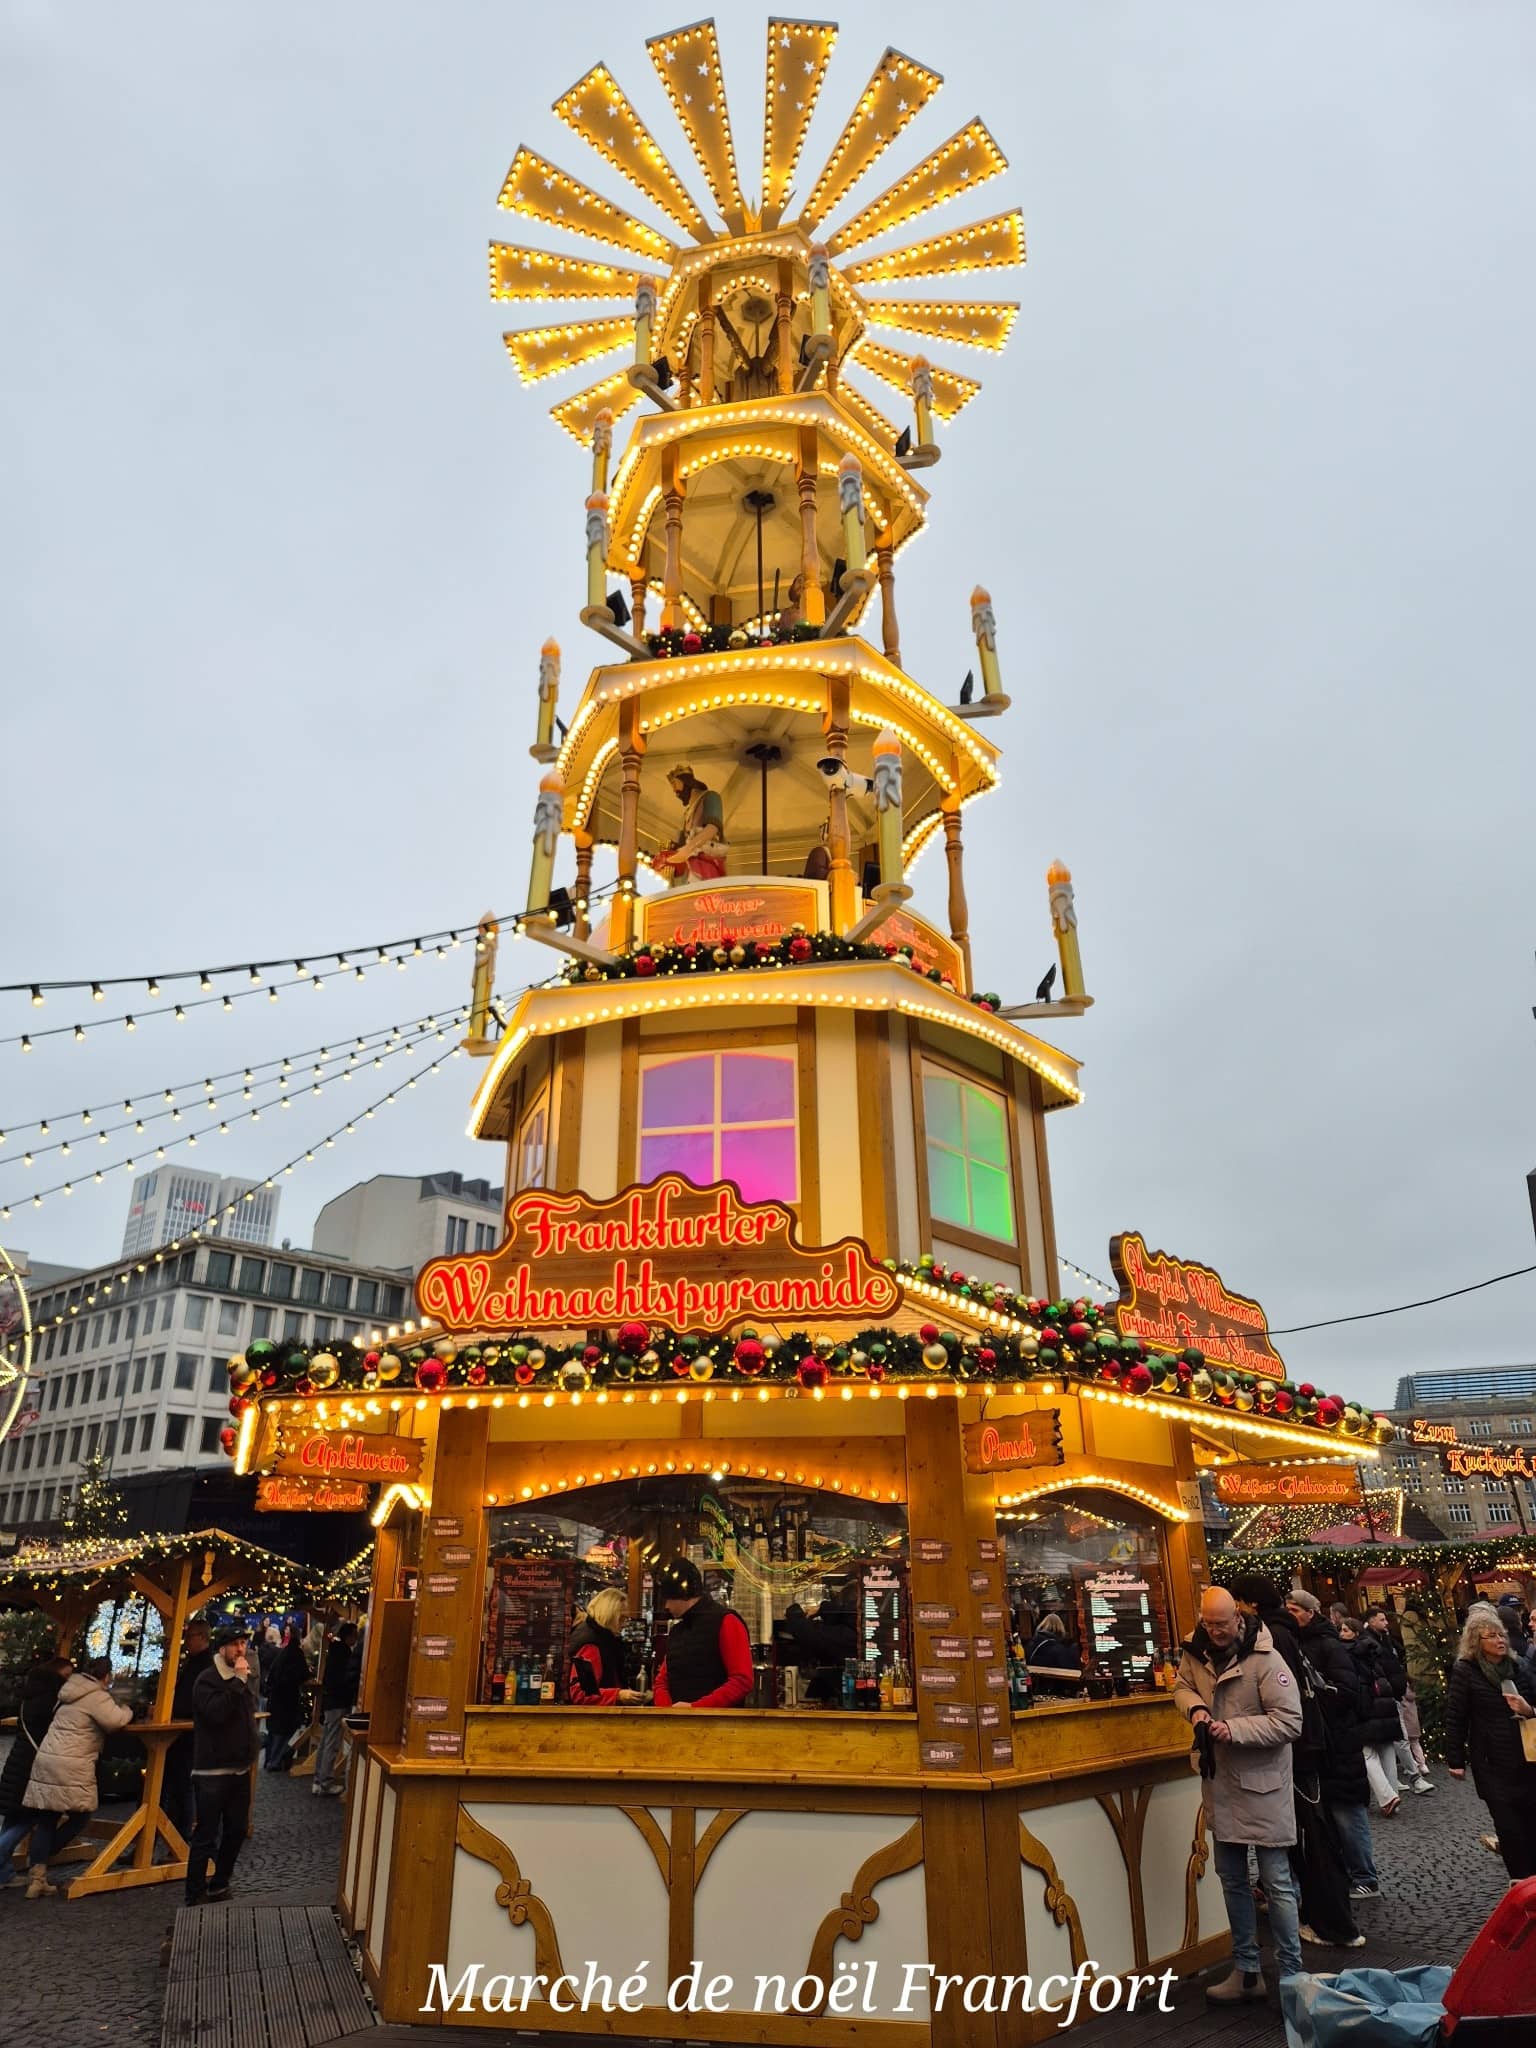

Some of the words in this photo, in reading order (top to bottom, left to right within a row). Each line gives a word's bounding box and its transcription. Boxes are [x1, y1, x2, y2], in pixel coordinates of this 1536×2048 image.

[673, 916, 784, 946] Glühwein
[514, 1183, 784, 1259] Frankfurter
[424, 1248, 892, 1327] Weihnachtspyramide
[1126, 1243, 1188, 1305] Herzlich
[1187, 1271, 1264, 1330] Willkommen
[1121, 1307, 1178, 1347] wünscht
[1176, 1311, 1231, 1362] Familie
[981, 1422, 1037, 1465] Punsch
[1413, 1419, 1458, 1443] Zum
[302, 1434, 409, 1475] Apfelwein
[1446, 1447, 1534, 1478] Kuckuck
[313, 1486, 364, 1510] Aperol
[1219, 1474, 1277, 1498] Weißer
[1278, 1475, 1349, 1499] Glühwein
